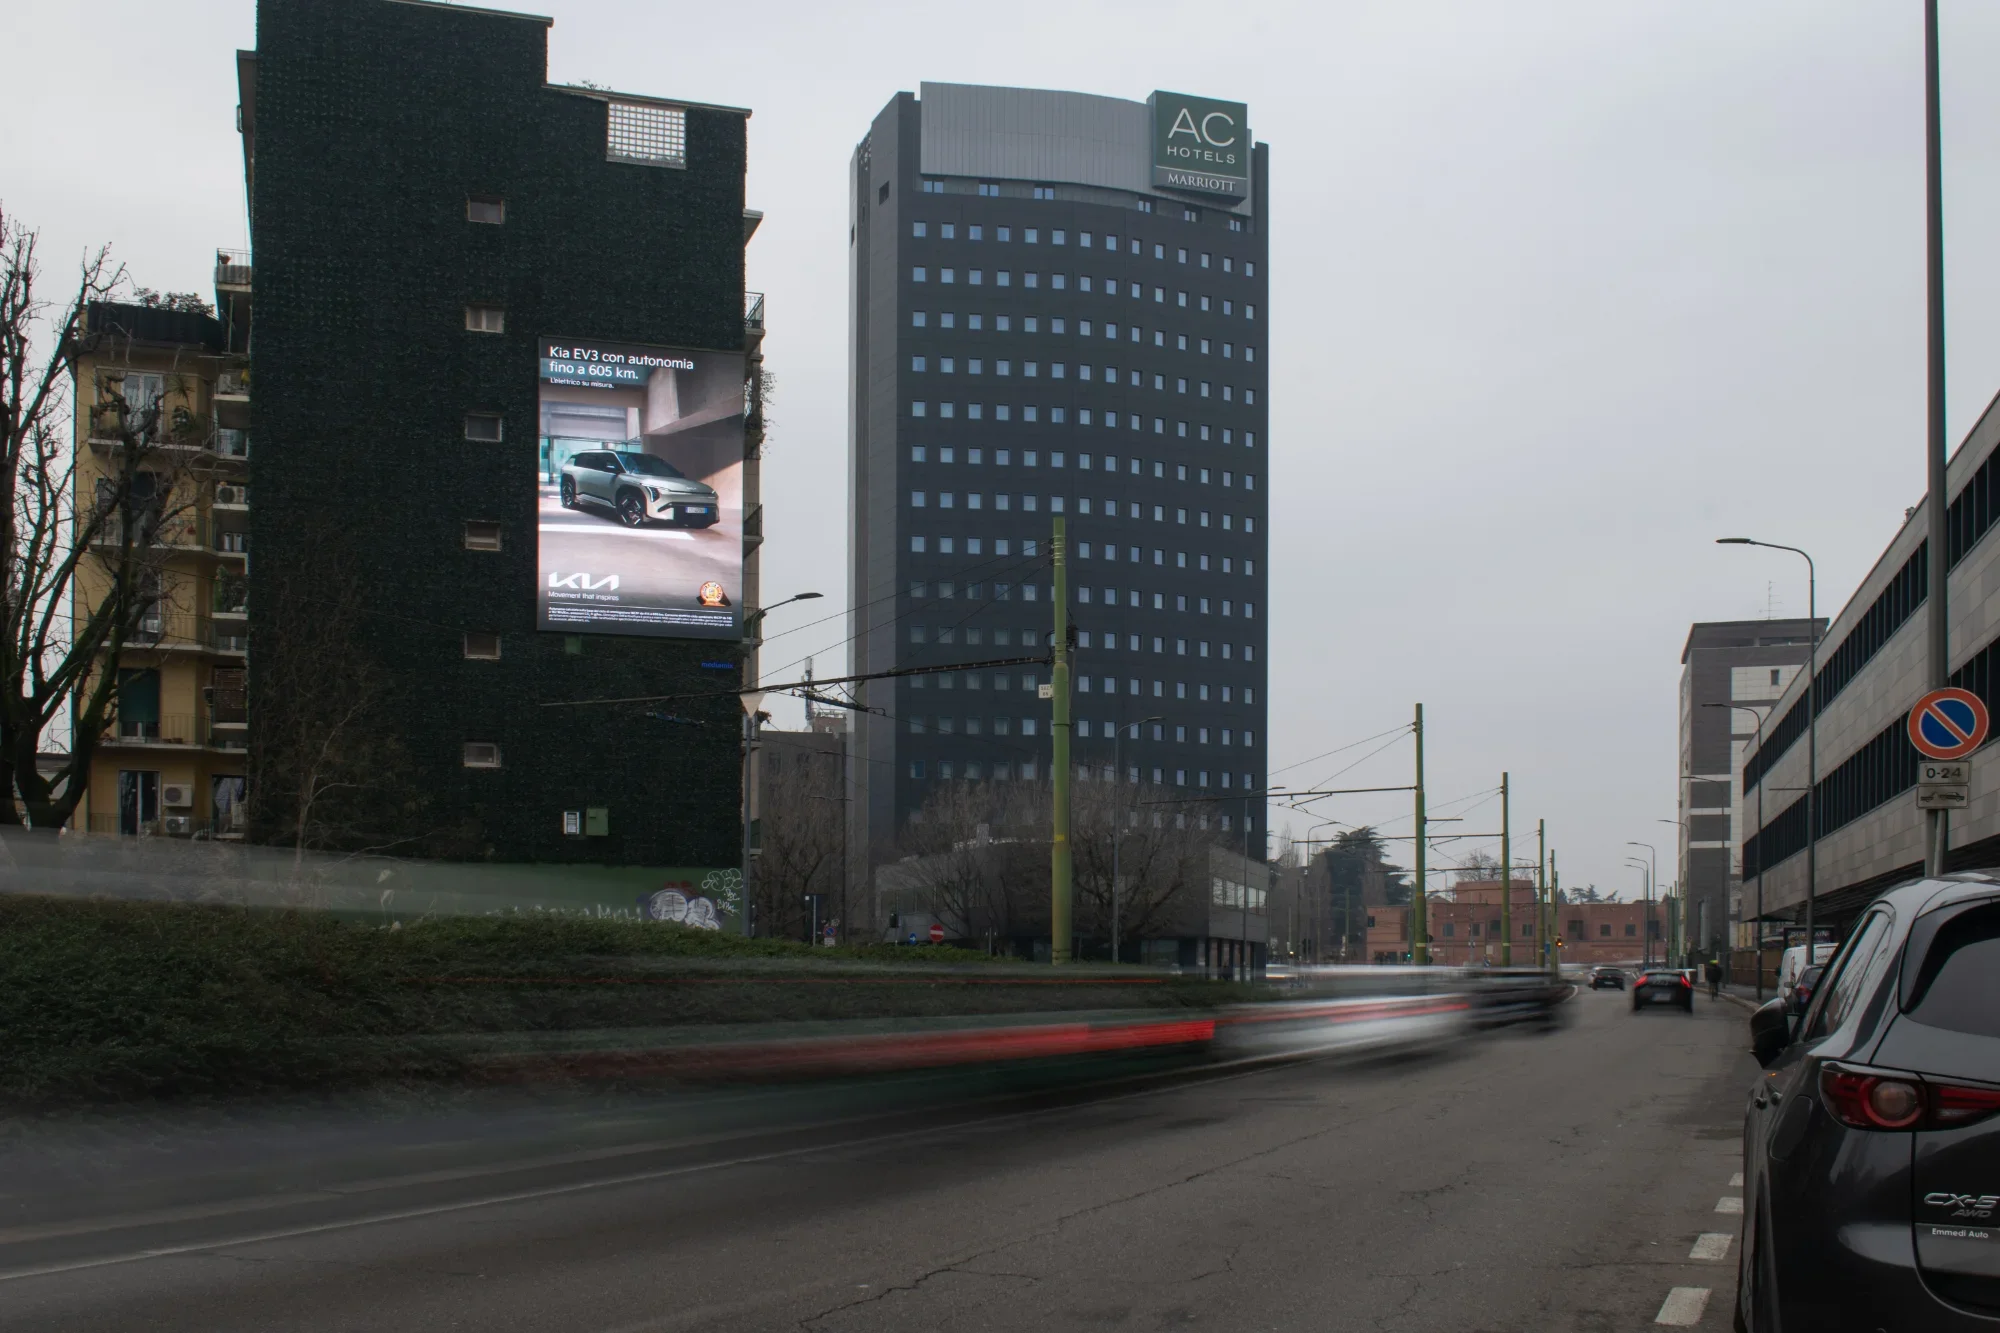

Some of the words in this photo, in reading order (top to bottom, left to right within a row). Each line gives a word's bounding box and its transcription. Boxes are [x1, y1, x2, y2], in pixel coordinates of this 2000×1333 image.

[1168, 108, 1235, 147] AC
[1167, 145, 1235, 164] HOTELS
[1168, 173, 1235, 191] MARRIOTT
[549, 346, 570, 359] Kia
[573, 348, 599, 361] EV3
[602, 353, 625, 363] con
[628, 354, 694, 370] autonomia
[549, 361, 575, 374] fino
[577, 366, 586, 375] a
[588, 364, 613, 377] 605
[616, 367, 639, 380] km.
[590, 381, 615, 389] misura.
[549, 571, 620, 591] KIA
[548, 591, 581, 599] Movement
[595, 594, 620, 602] inspires
[1926, 767, 1962, 779] 0-24
[1924, 1192, 2000, 1208] CX-5
[1951, 1209, 1992, 1218] AWD
[1932, 1228, 1966, 1237] Emmedi
[1968, 1231, 1989, 1239] Auto
